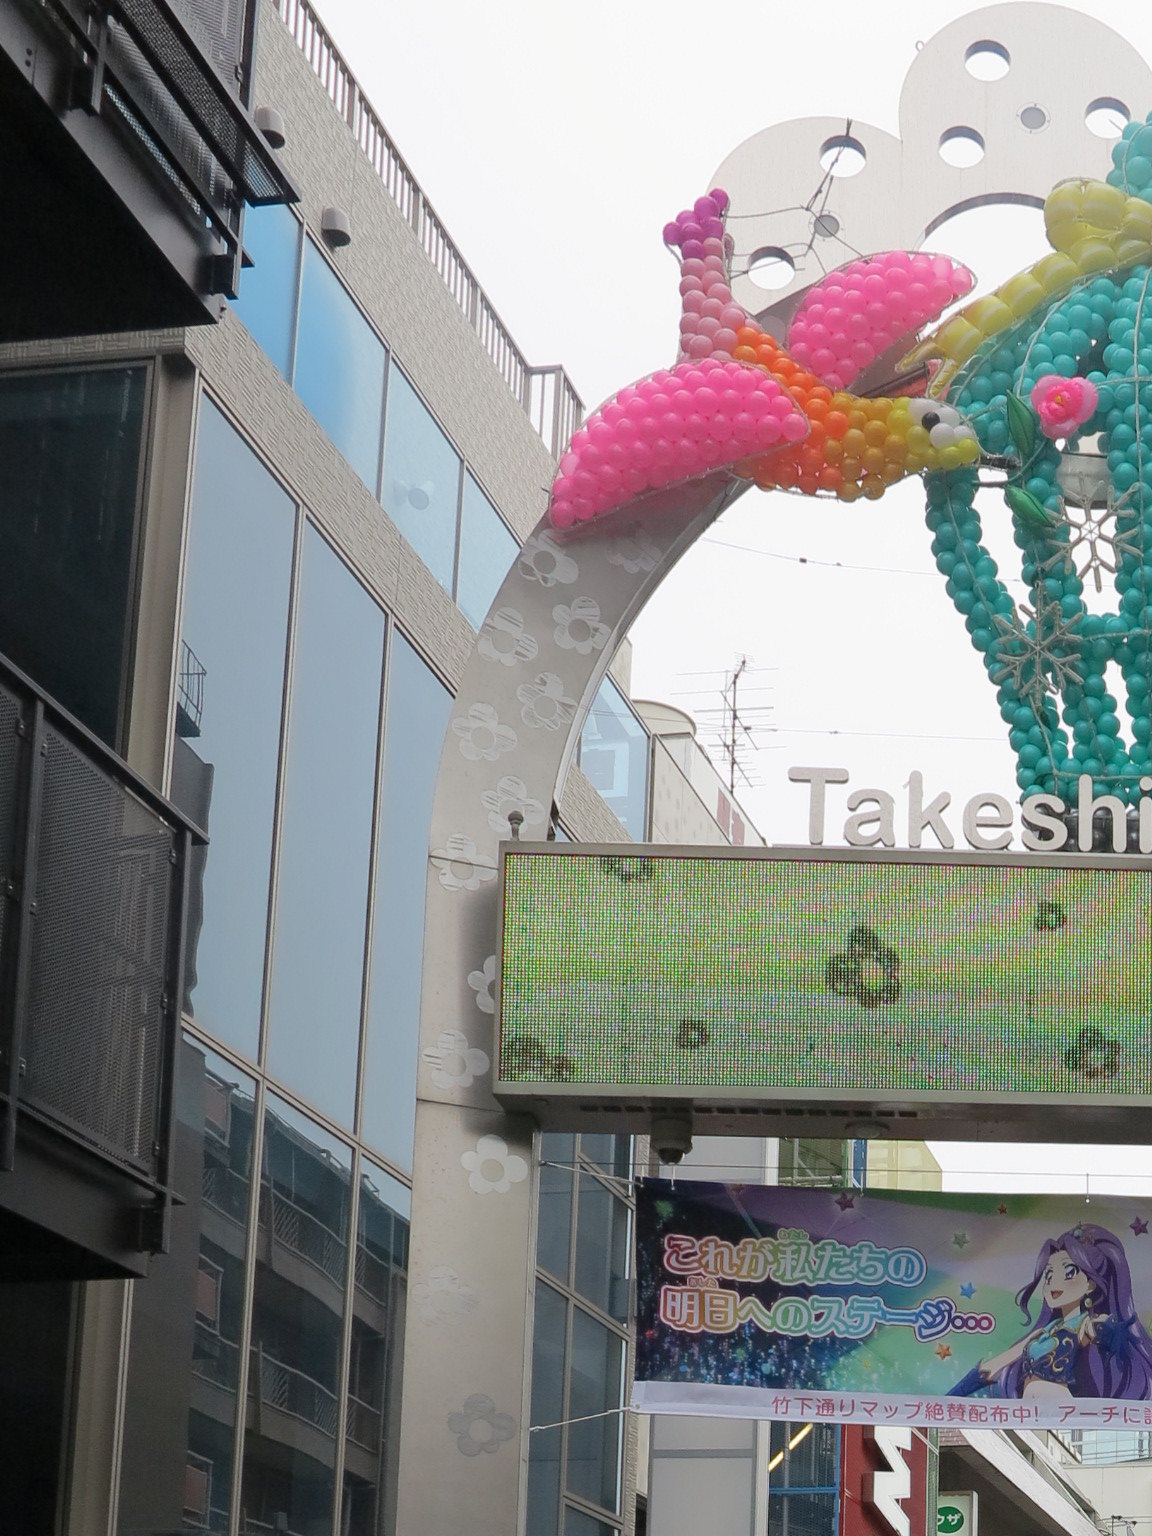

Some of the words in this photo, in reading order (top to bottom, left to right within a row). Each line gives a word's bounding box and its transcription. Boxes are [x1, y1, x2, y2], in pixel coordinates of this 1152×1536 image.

[664, 1234, 926, 1286] これが私たちの
[772, 1396, 1040, 1424] 竹下通りマップ絶賛配布中!
